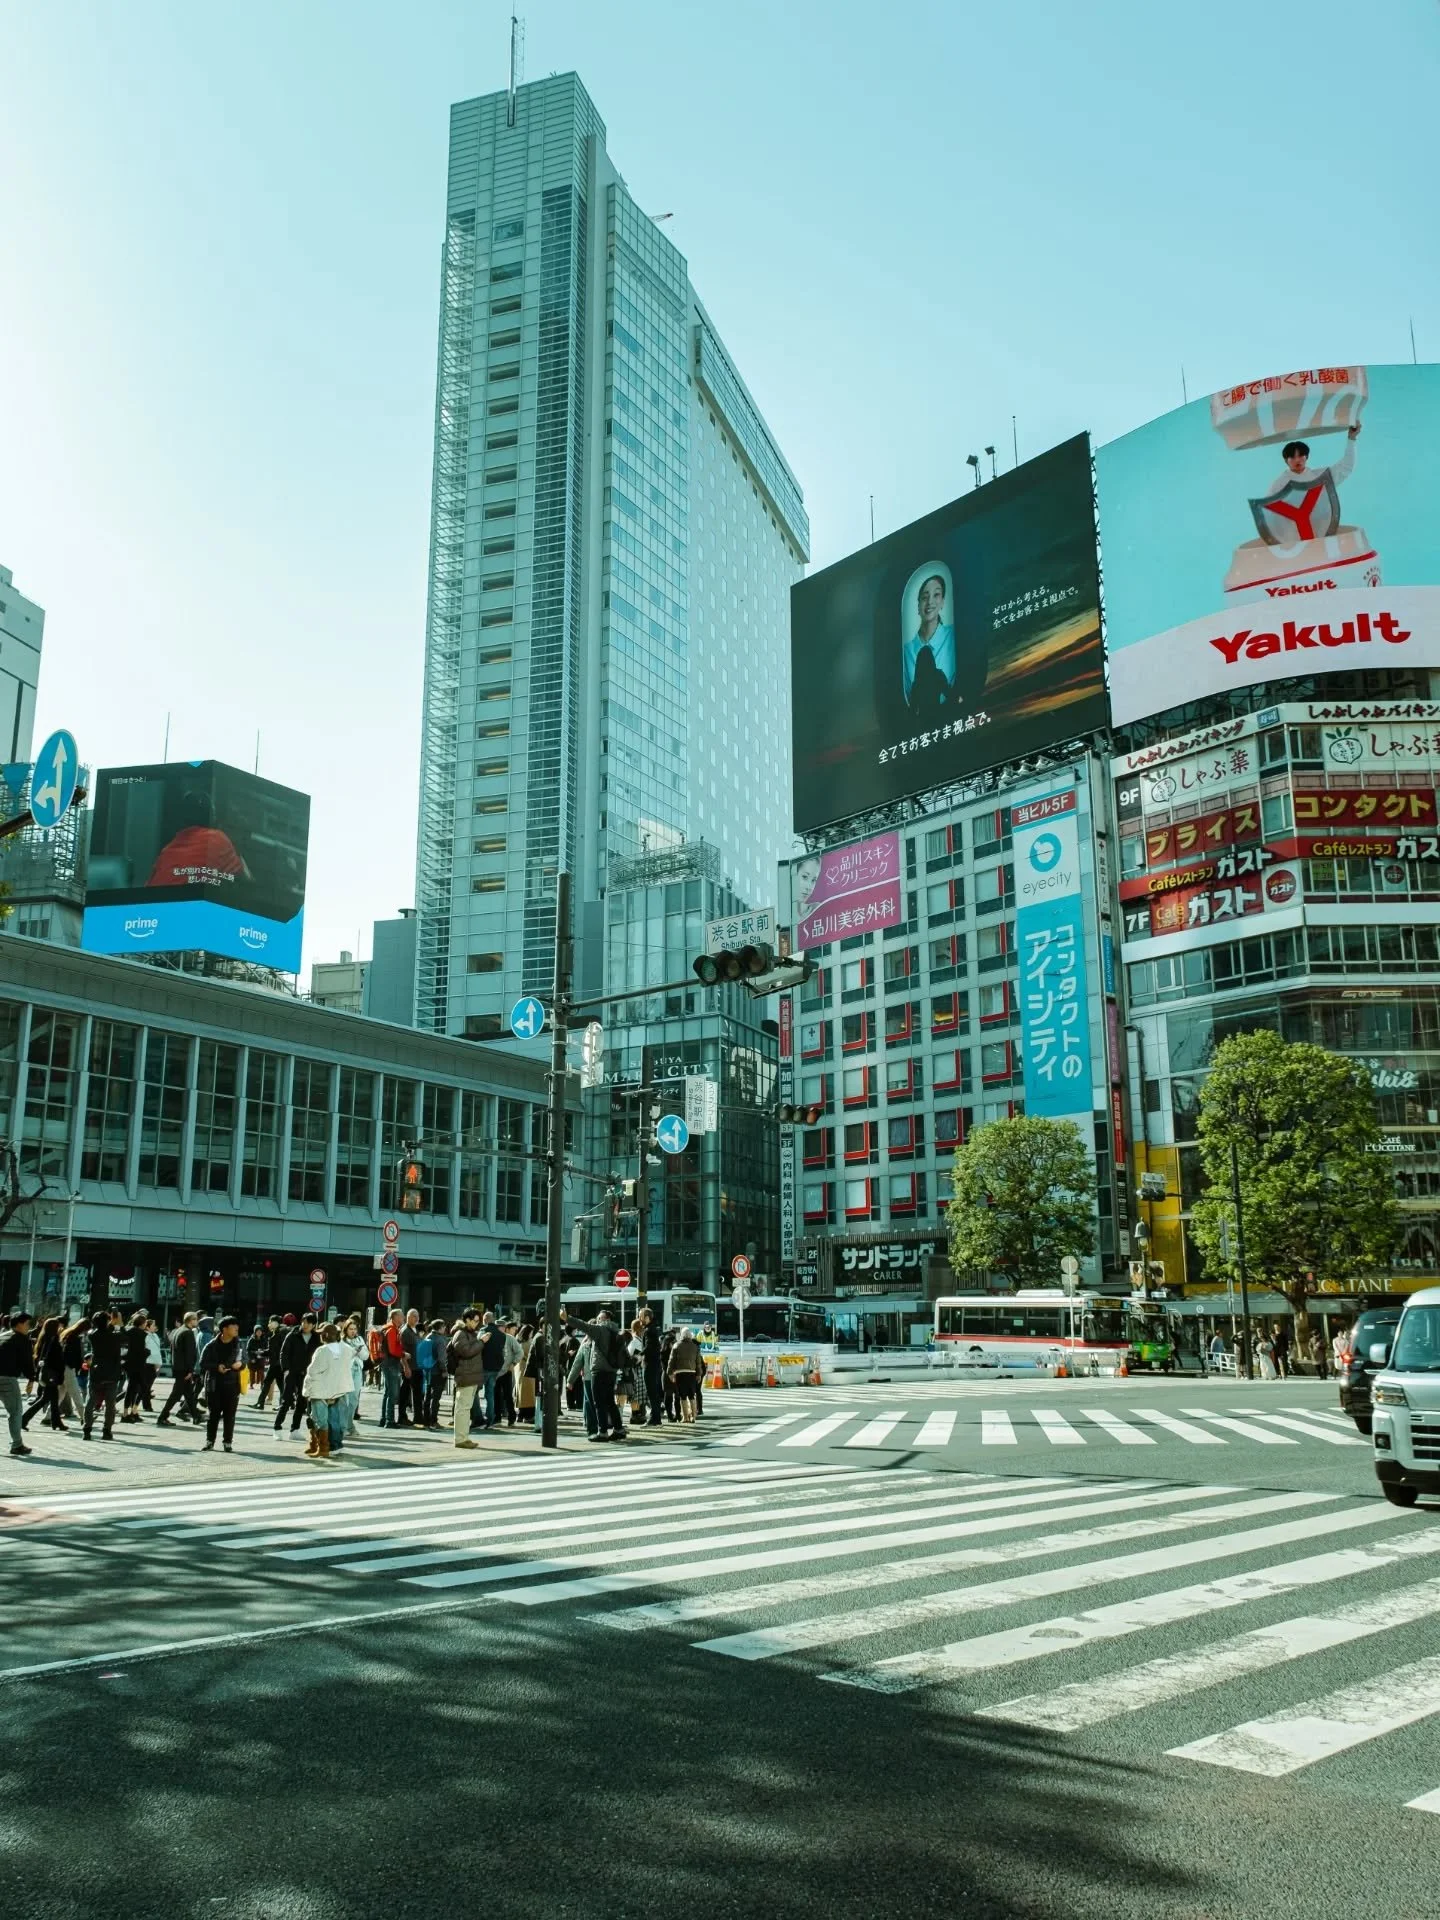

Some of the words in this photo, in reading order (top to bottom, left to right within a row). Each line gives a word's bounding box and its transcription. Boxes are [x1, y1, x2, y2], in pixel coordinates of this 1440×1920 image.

[992, 585, 1050, 615] ゼロから考える。
[1265, 579, 1337, 597] Yakult
[1209, 612, 1411, 664] Yakult
[878, 711, 992, 765] 全てをお客さま視点で。
[1127, 719, 1245, 769] しゃぶしゃぶバイキング
[1181, 749, 1249, 790] しゃぶ葉
[1018, 794, 1069, 823] 当ビル5F
[1119, 787, 1140, 807] 9F
[1295, 794, 1431, 818] コンタクト
[1148, 808, 1257, 858] プライス
[840, 843, 894, 872] 品川スキン
[1312, 842, 1392, 856] Caféレストラン
[841, 861, 888, 887] クリニック
[1023, 871, 1072, 896] eyecity
[1148, 865, 1214, 893] Caféレストラン
[1217, 847, 1273, 880] ガスト
[1270, 883, 1294, 896] ガスト
[811, 897, 896, 938] 品川美容外科
[1188, 886, 1257, 926] ガスト
[125, 917, 158, 930] prime
[239, 926, 267, 942] prime
[711, 913, 769, 942] 渋谷駅前
[1125, 911, 1150, 932] 7F
[1025, 929, 1058, 1082] アイシティ
[1056, 923, 1083, 1079] コンタクトの
[630, 1056, 683, 1068] SUYA
[667, 1063, 714, 1077] CITY
[694, 1081, 703, 1130] 渋谷駅前
[842, 1243, 935, 1270] サンドラッグ
[1282, 1276, 1392, 1293] L'CITANE
